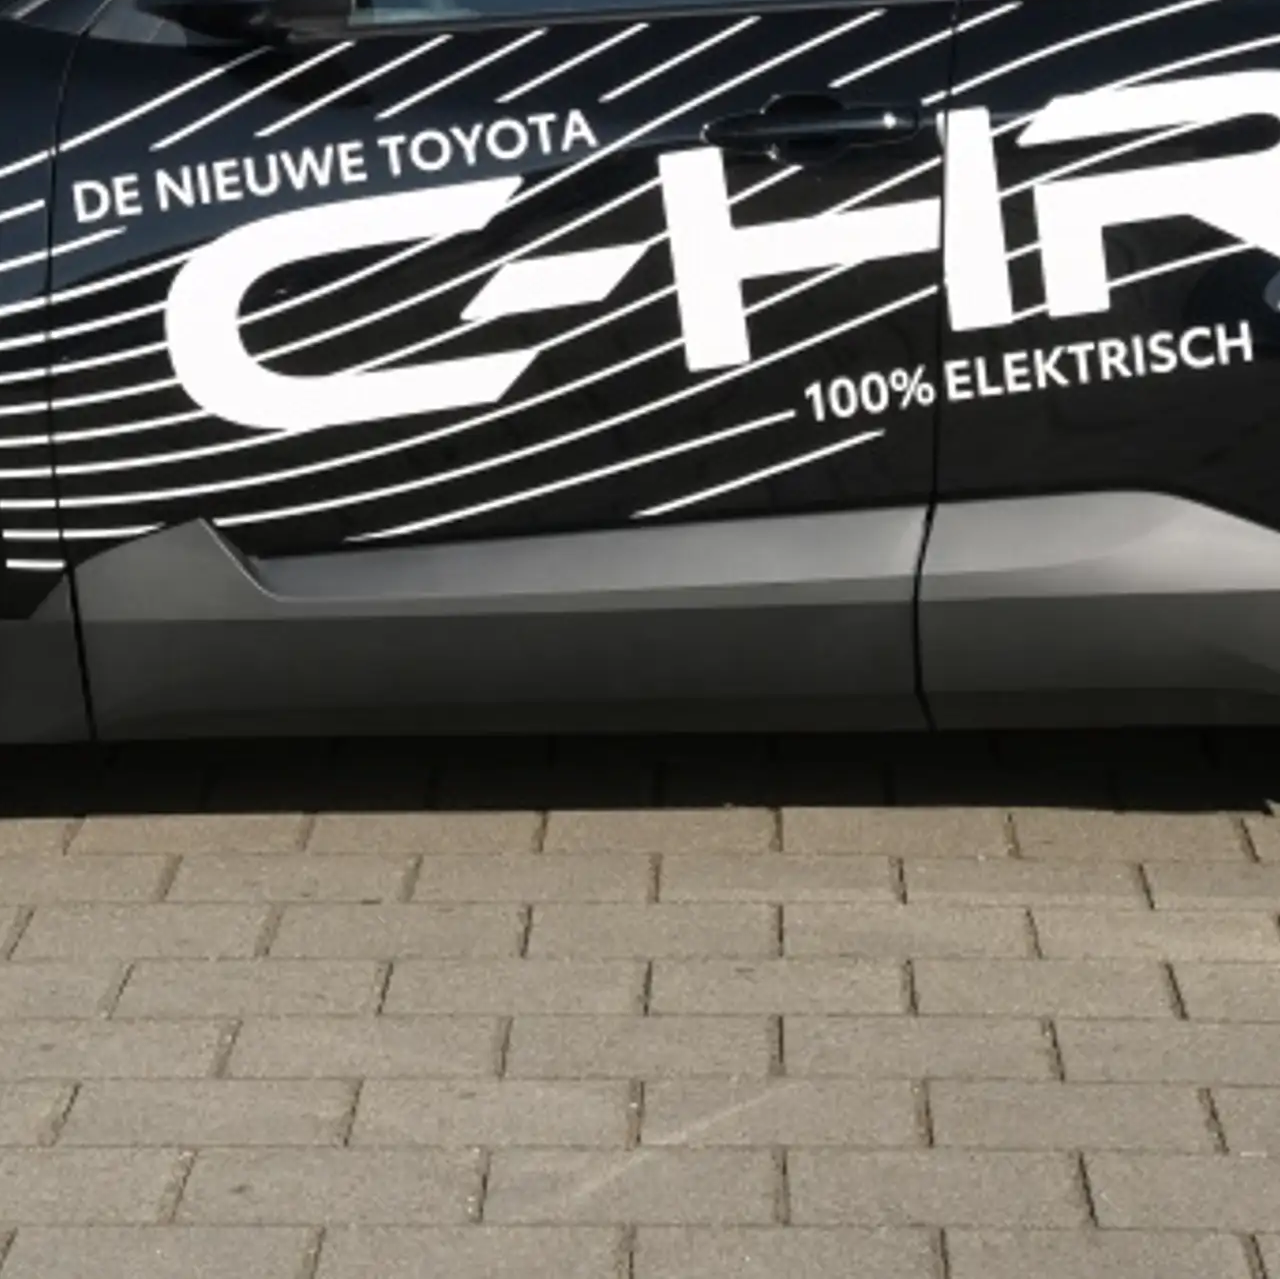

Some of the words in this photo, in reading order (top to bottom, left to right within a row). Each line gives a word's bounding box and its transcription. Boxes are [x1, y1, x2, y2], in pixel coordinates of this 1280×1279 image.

[71, 173, 144, 225] DE
[154, 139, 369, 213] NIEUWE
[375, 108, 600, 178] TOYOTA
[803, 365, 937, 423] 100%
[944, 321, 1254, 402] ELEKTRISCH
